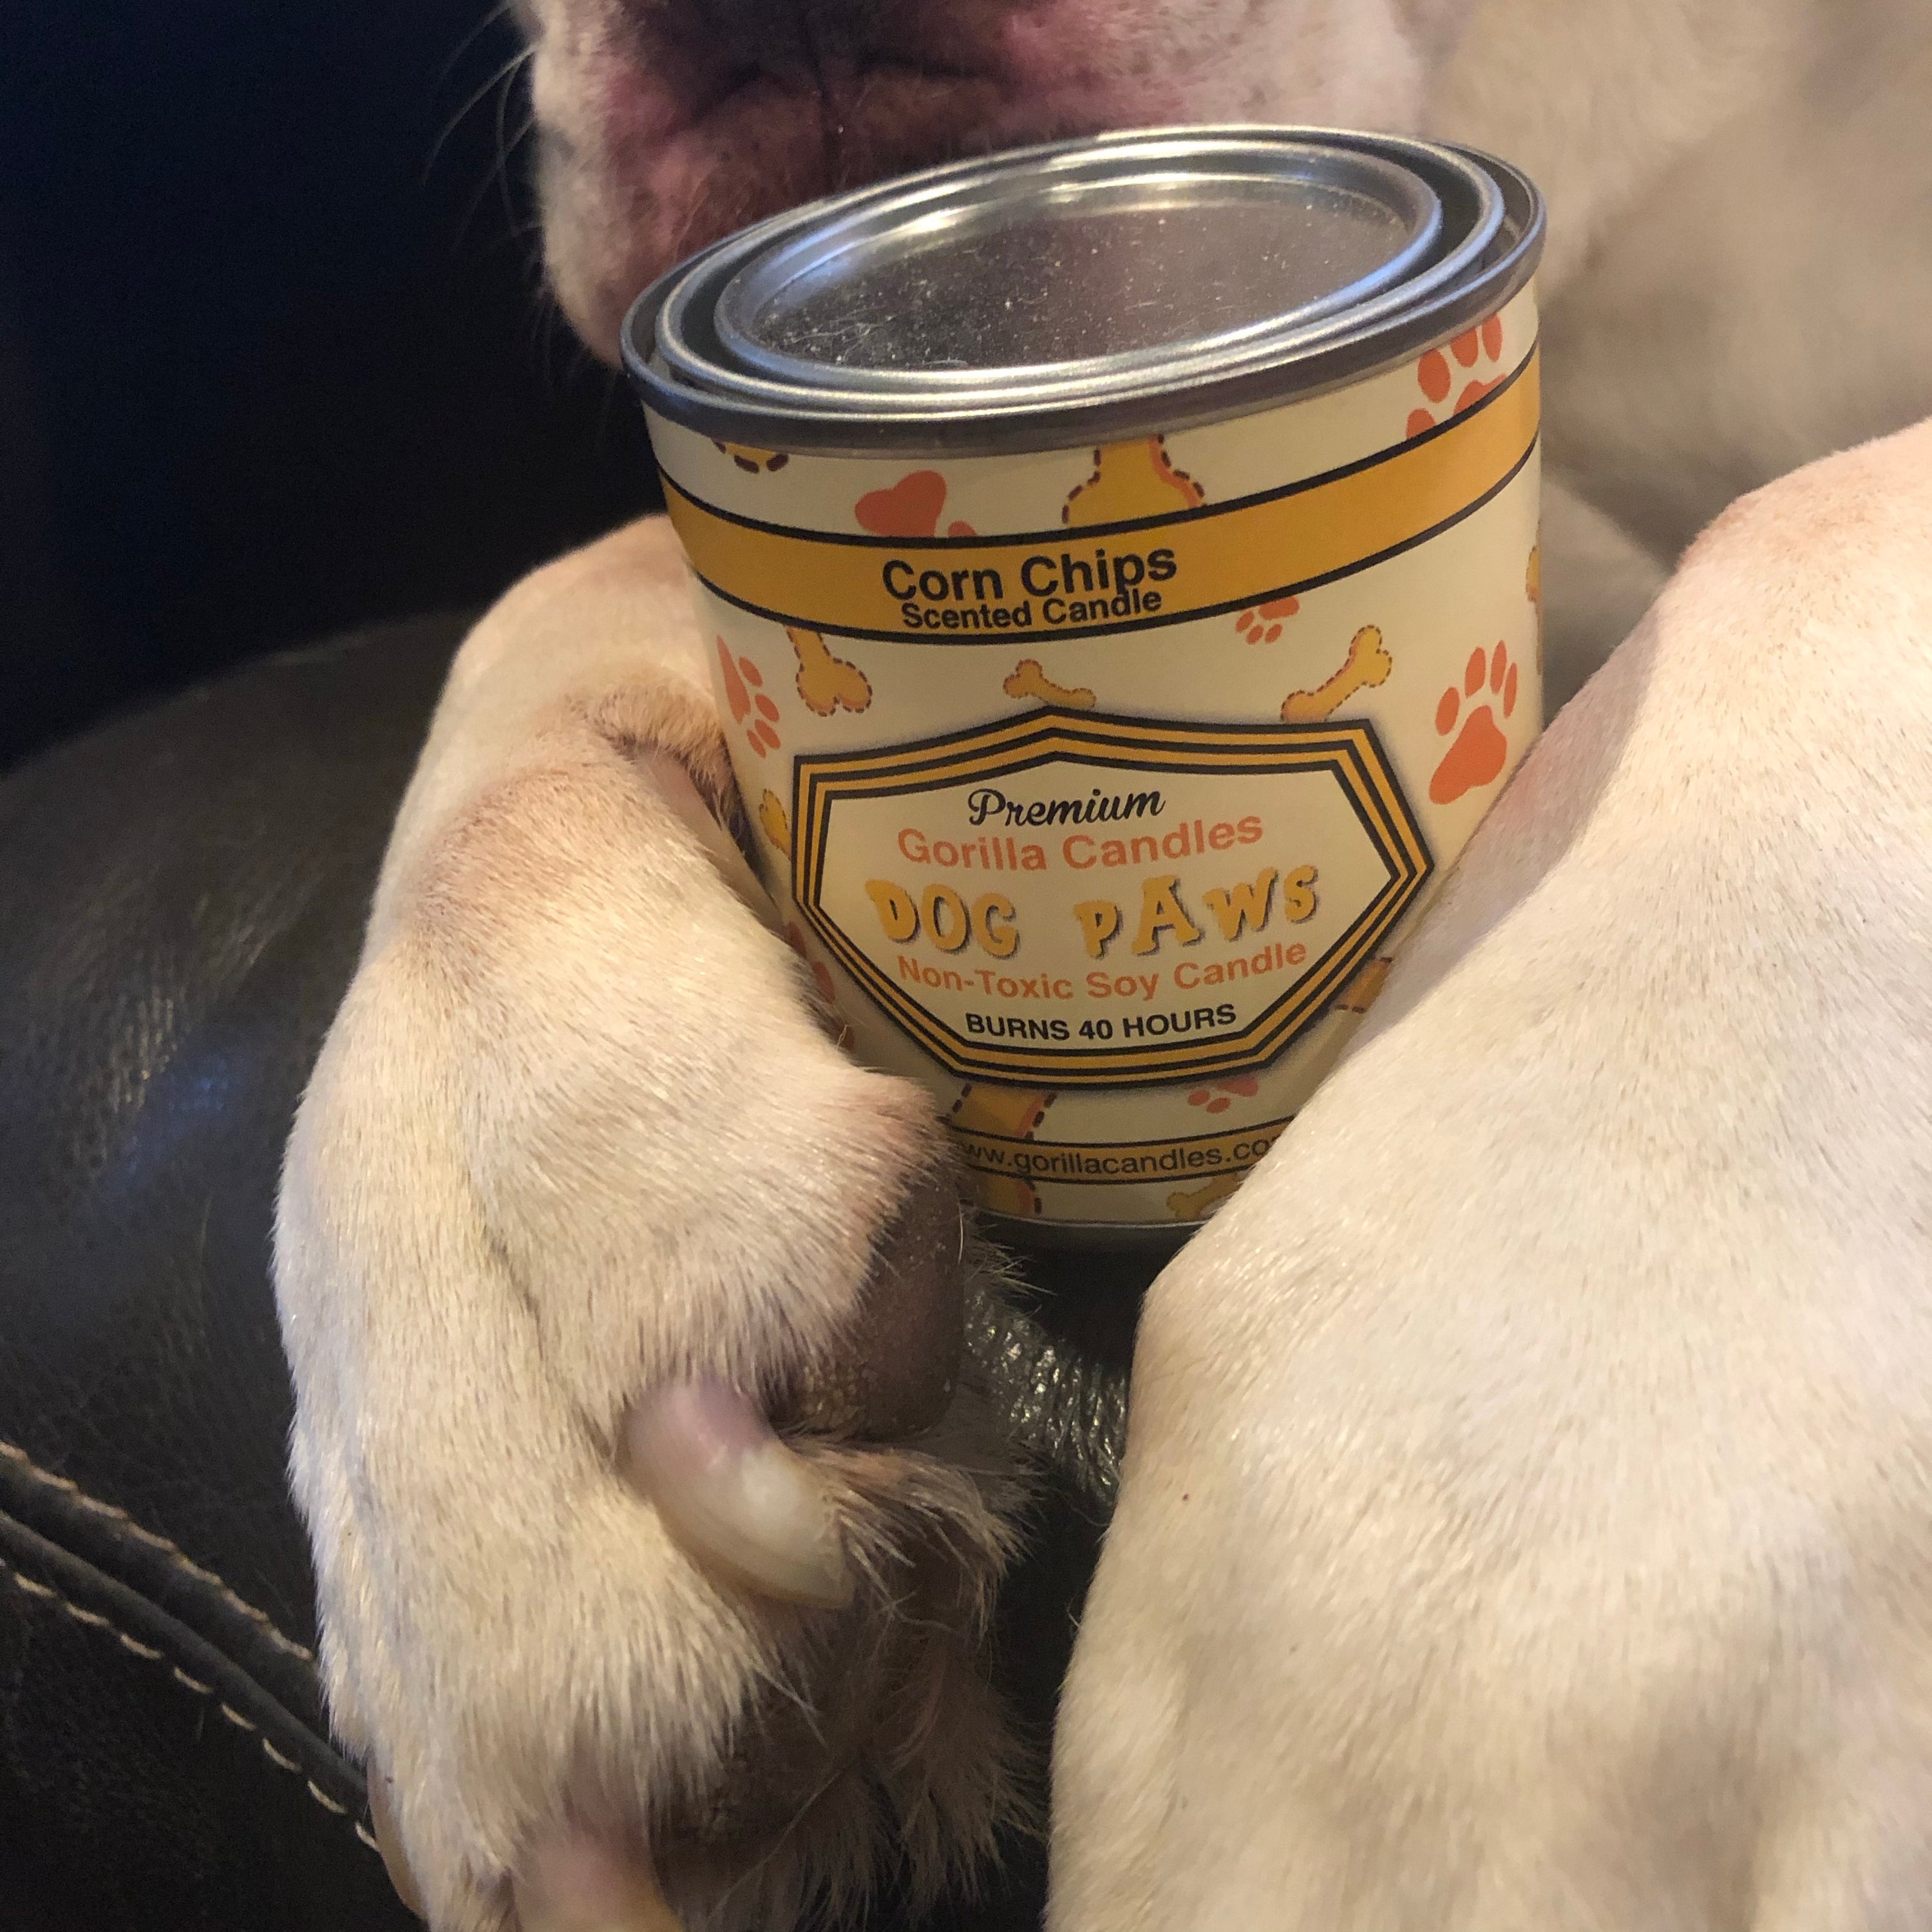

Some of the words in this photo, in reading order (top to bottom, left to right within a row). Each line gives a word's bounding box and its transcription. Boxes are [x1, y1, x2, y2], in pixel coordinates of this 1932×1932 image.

[882, 559, 1003, 600] Corn
[1021, 548, 1177, 595] Chips
[902, 601, 1032, 629] Scented
[1043, 589, 1162, 625] Candle
[968, 788, 1166, 826] Premium
[898, 829, 1046, 871] Gorilla
[1063, 815, 1264, 870] Candles
[865, 879, 1020, 958] DOG
[1074, 865, 1318, 958] PAWS
[898, 954, 1073, 999] Non-Toxic
[1086, 971, 1159, 1001] Soy
[1174, 942, 1307, 990] Candle
[965, 1012, 1069, 1041] BURNS
[1079, 1019, 1112, 1039] 40
[1122, 1003, 1236, 1038] HOURS
[958, 1133, 1282, 1175] ww.gorillacandles.co
